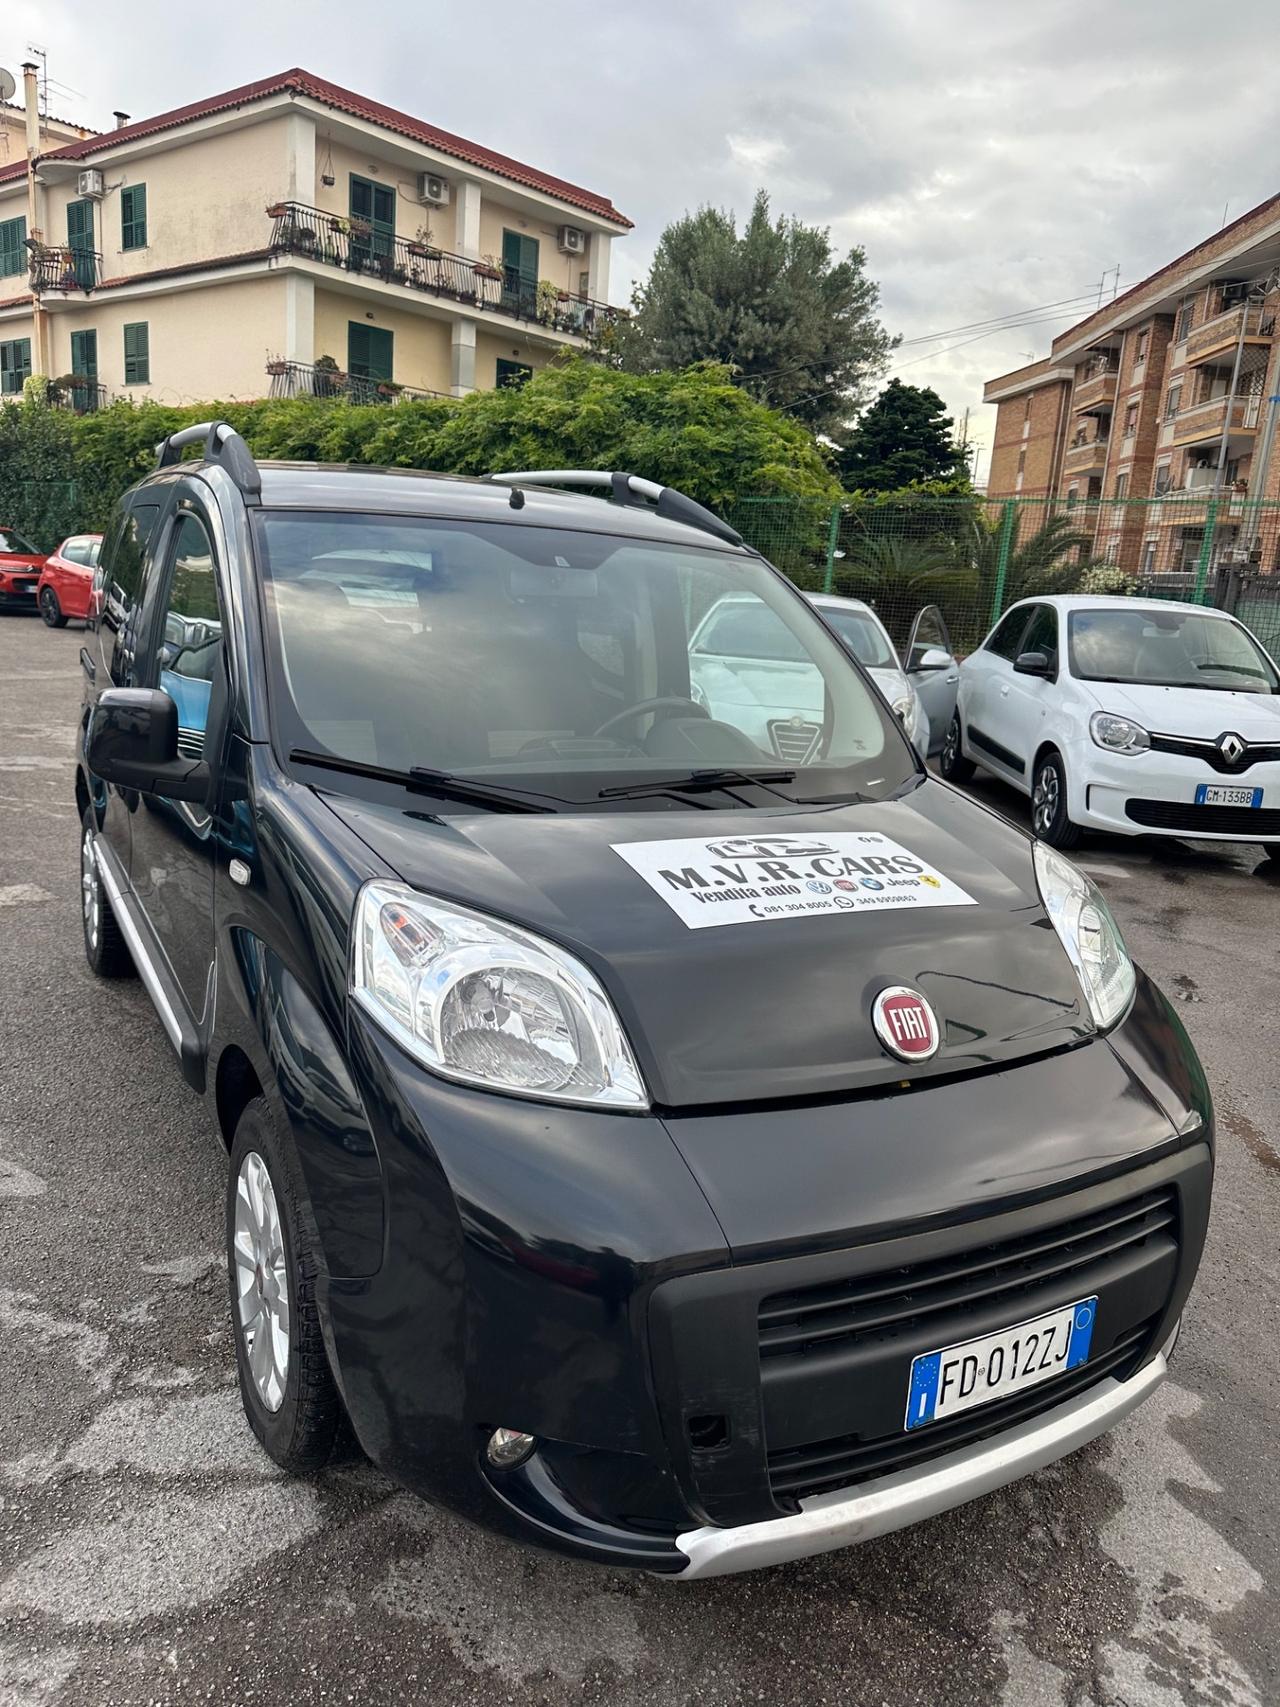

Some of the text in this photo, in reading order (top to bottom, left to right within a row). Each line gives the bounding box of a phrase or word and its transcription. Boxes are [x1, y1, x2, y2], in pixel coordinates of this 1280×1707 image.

[887, 878, 921, 887] Jeep
[690, 884, 801, 903] Vendita auto
[763, 901, 832, 913] 081 304 8005
[888, 1006, 928, 1041] FIAT
